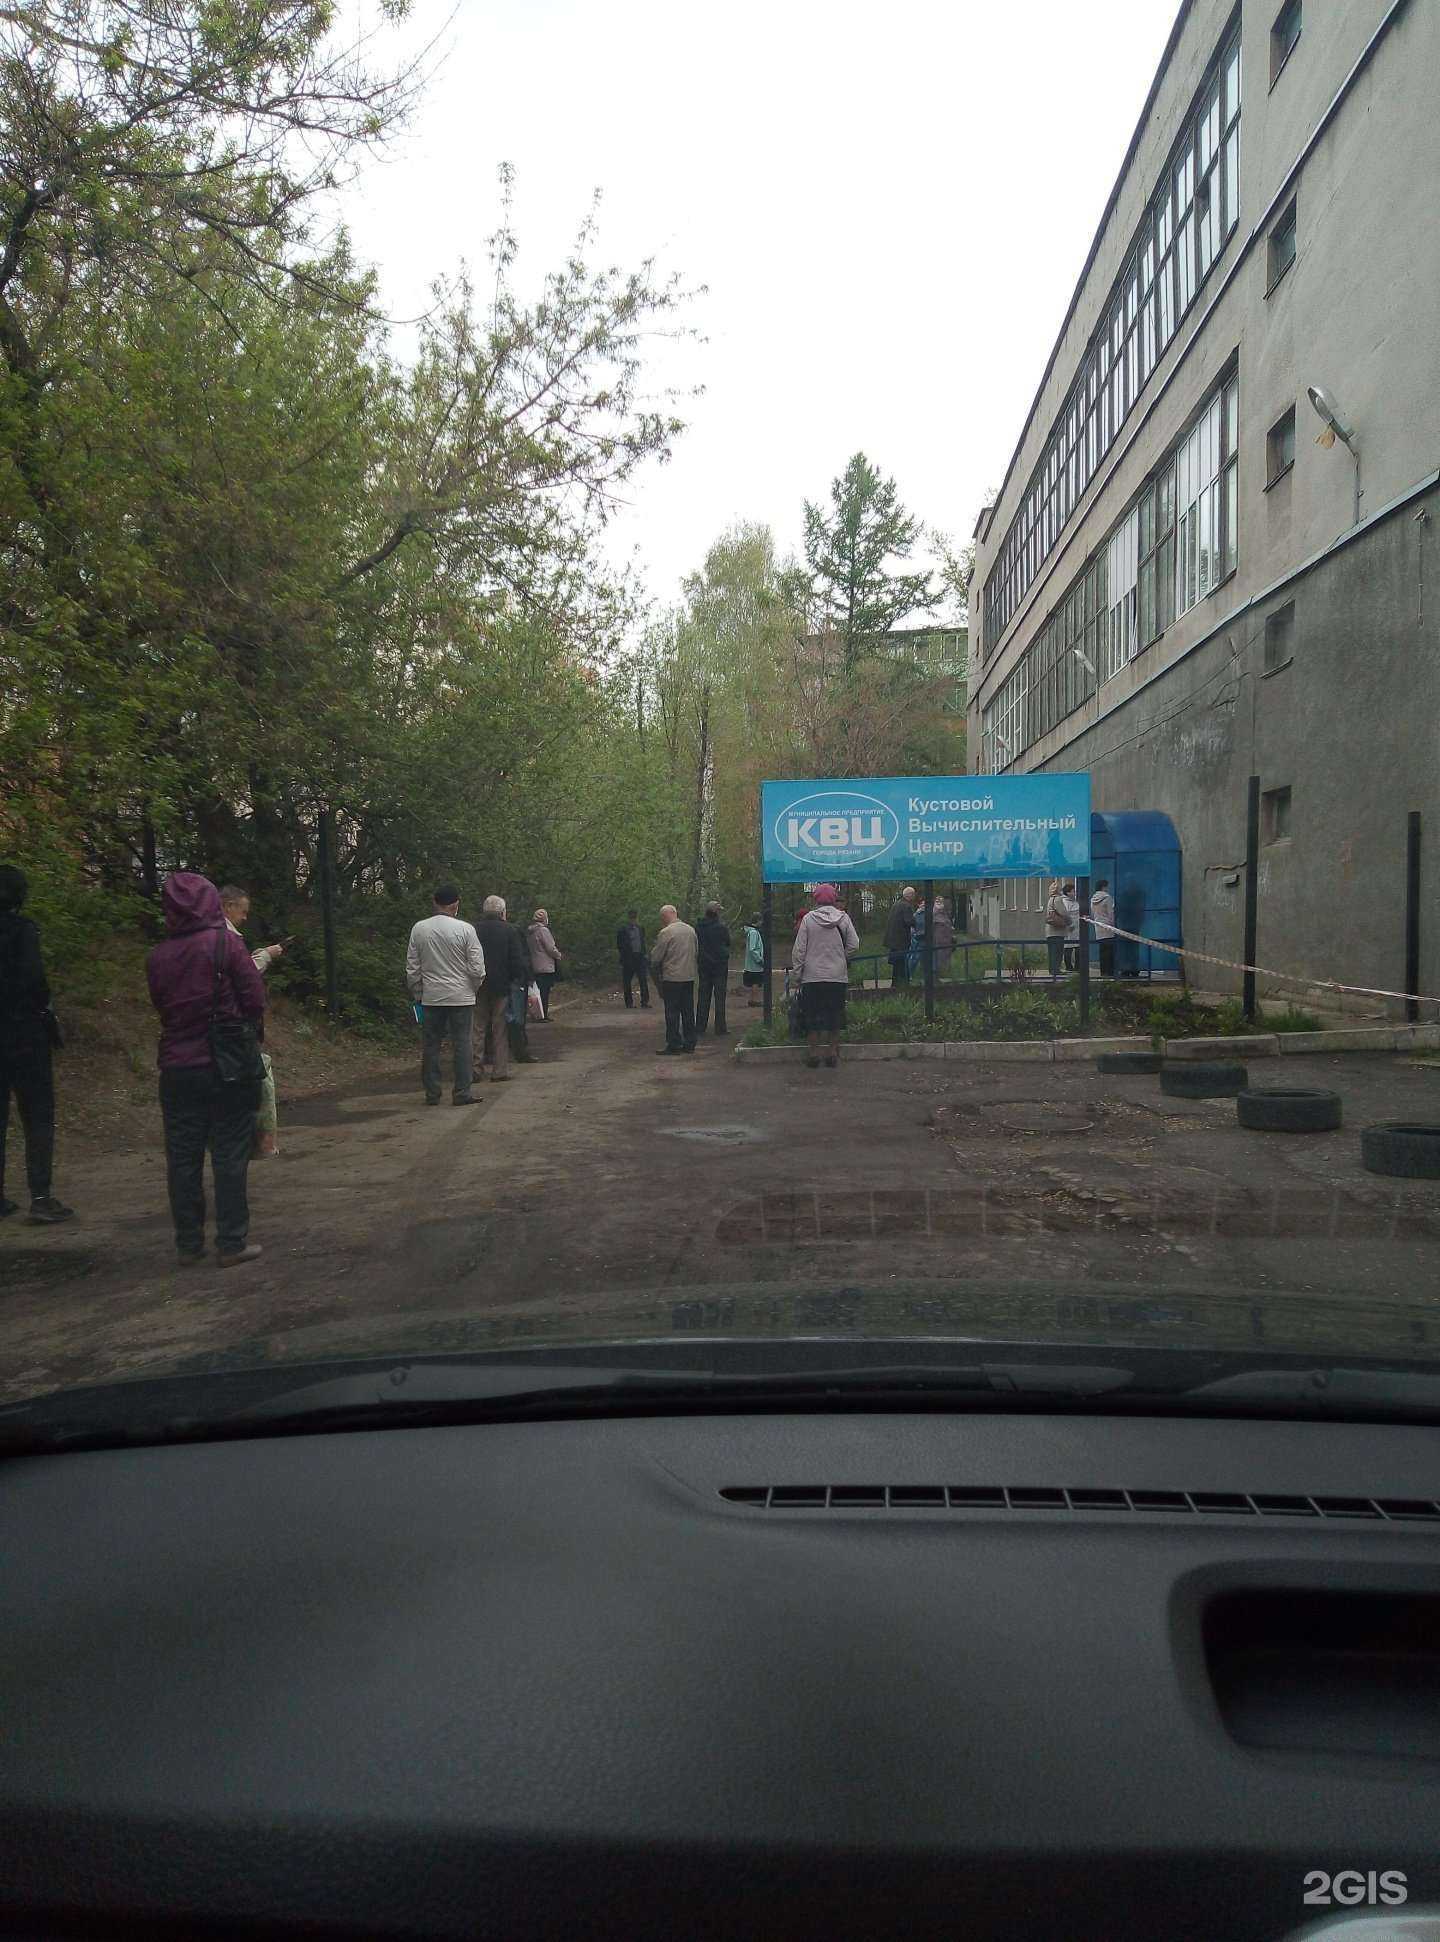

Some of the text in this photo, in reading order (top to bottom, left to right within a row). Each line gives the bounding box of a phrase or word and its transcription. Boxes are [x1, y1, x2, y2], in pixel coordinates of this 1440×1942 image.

[908, 795, 993, 814] Кустовой
[788, 817, 886, 848] КВЦ
[908, 814, 1076, 833] Вычислительный
[908, 839, 964, 855] Центр
